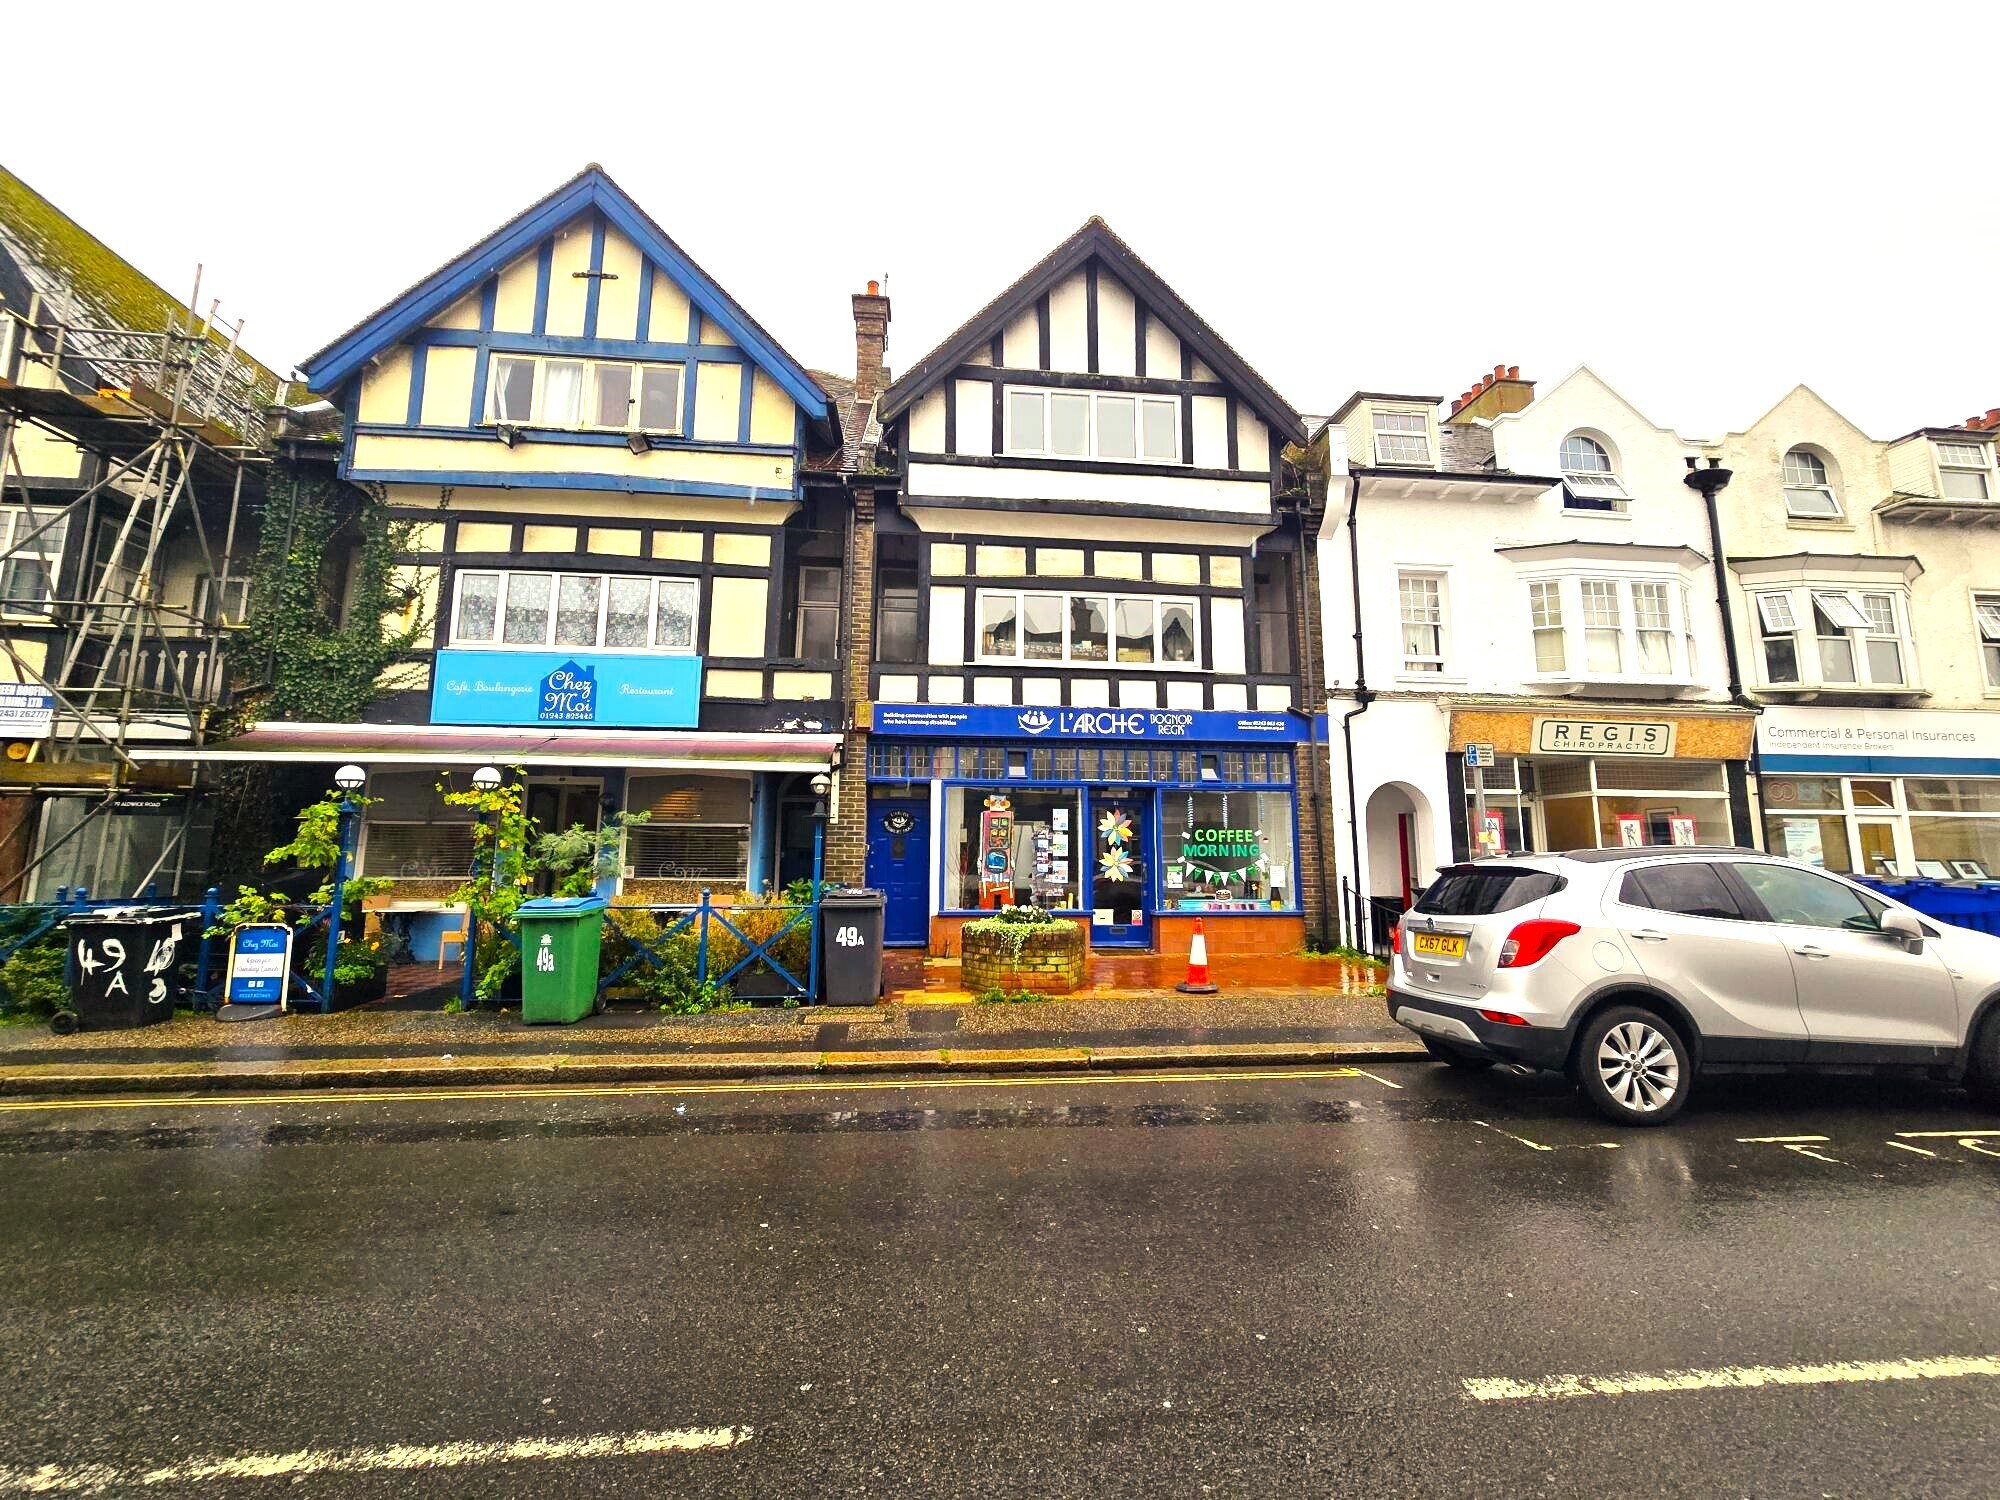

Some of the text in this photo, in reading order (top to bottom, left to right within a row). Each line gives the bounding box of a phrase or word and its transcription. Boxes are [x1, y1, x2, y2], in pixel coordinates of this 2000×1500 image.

[474, 681, 533, 697] Boulangerie
[548, 670, 592, 698] Chez
[620, 683, 674, 696] Restaurant
[544, 692, 592, 712] Moi
[1060, 711, 1145, 735] L'ARCHE
[1150, 713, 1193, 725] BOGNOR
[1158, 724, 1185, 736] REGIS
[1555, 725, 1657, 743] REGIS
[1768, 726, 1976, 742] Commercial & Personal Insurances
[1553, 740, 1656, 751] CHIROPRACTIC
[1769, 741, 1894, 751] Independent Insurance Brokers
[1194, 829, 1253, 843] COFFEE
[1183, 844, 1259, 857] MORNING
[242, 939, 279, 951] Chez Moi
[1419, 936, 1459, 953] CX67 GLK
[77, 938, 127, 976] 49
[536, 946, 555, 972] 49a
[104, 970, 129, 998] A
